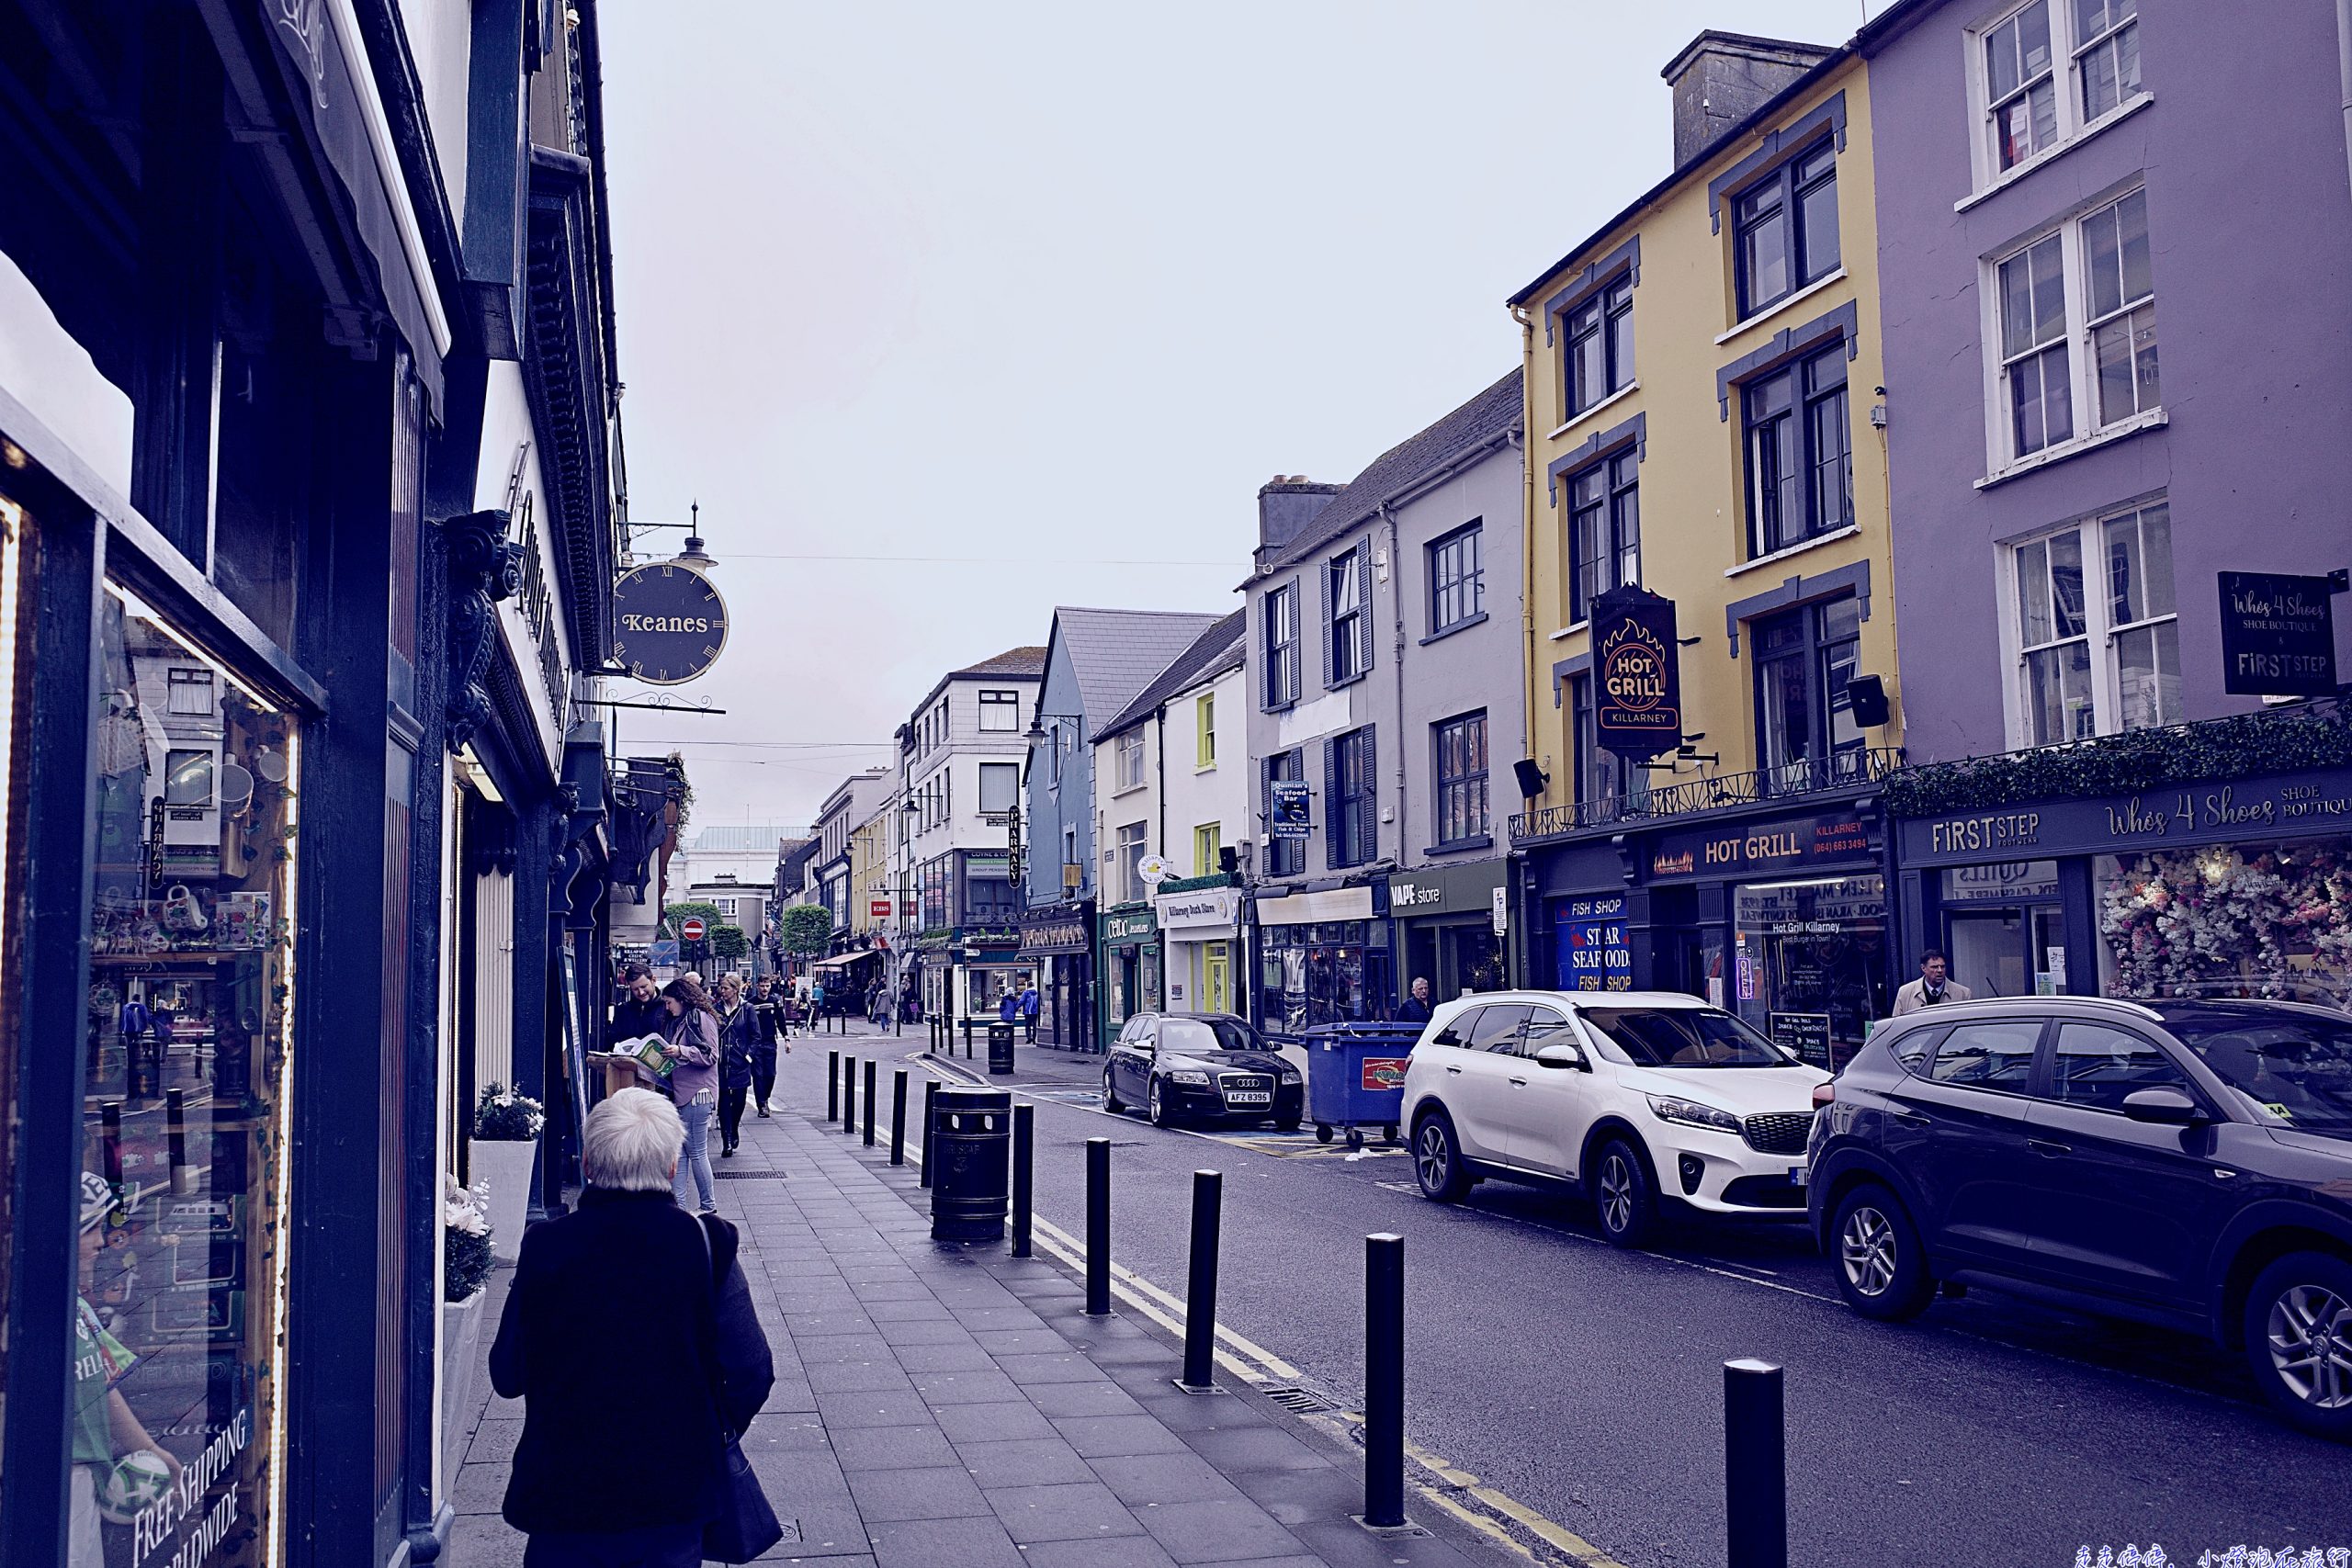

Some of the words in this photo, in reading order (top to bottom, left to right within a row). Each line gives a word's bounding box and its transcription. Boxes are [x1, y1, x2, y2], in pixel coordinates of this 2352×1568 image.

[2273, 594, 2284, 615] 4
[2286, 592, 2325, 619] Shoes
[621, 614, 707, 632] Keanes
[2243, 619, 2267, 629] SHOE
[2269, 621, 2318, 632] BOUTIQUE
[1618, 658, 1652, 673] HOT
[2294, 655, 2327, 672] STEP
[1607, 677, 1665, 696] GRILL
[1612, 713, 1667, 723] KILLARNEY
[2281, 784, 2320, 801] SHOE
[2175, 794, 2195, 830] 4
[2205, 785, 2276, 826] Shoes
[2282, 797, 2352, 818] BOUTIQU
[1815, 821, 1863, 837] KILLARNEY
[1996, 813, 2039, 838] STEP
[1010, 812, 1019, 880] PHARMACY
[1705, 839, 1741, 863] HOT
[1746, 832, 1802, 860] GRILL
[1814, 840, 1832, 853] (064)
[1833, 840, 1847, 852] 663
[1848, 838, 1867, 851] 3494
[1998, 837, 2038, 846] FOOTWEAR
[1390, 884, 1416, 907] VAPE
[1418, 886, 1441, 904] store
[1169, 906, 1189, 919] Killarney
[1189, 904, 1202, 915] Duck
[1201, 902, 1216, 913] Store
[1572, 902, 1591, 916] FISH
[1595, 899, 1622, 915] SHOP
[1772, 923, 1786, 933] Hot
[1787, 921, 1804, 933] Grill
[1805, 920, 1840, 934] Killarney
[1794, 935, 1809, 944] Burger
[1578, 976, 1600, 991] FISH
[1607, 976, 1632, 991] SHOP
[1740, 960, 1748, 998] OPEN
[1230, 1093, 1247, 1101] AFZ
[1248, 1093, 1267, 1101] 8395
[133, 1487, 175, 1568] FREE
[178, 1408, 246, 1521] SHIPPING
